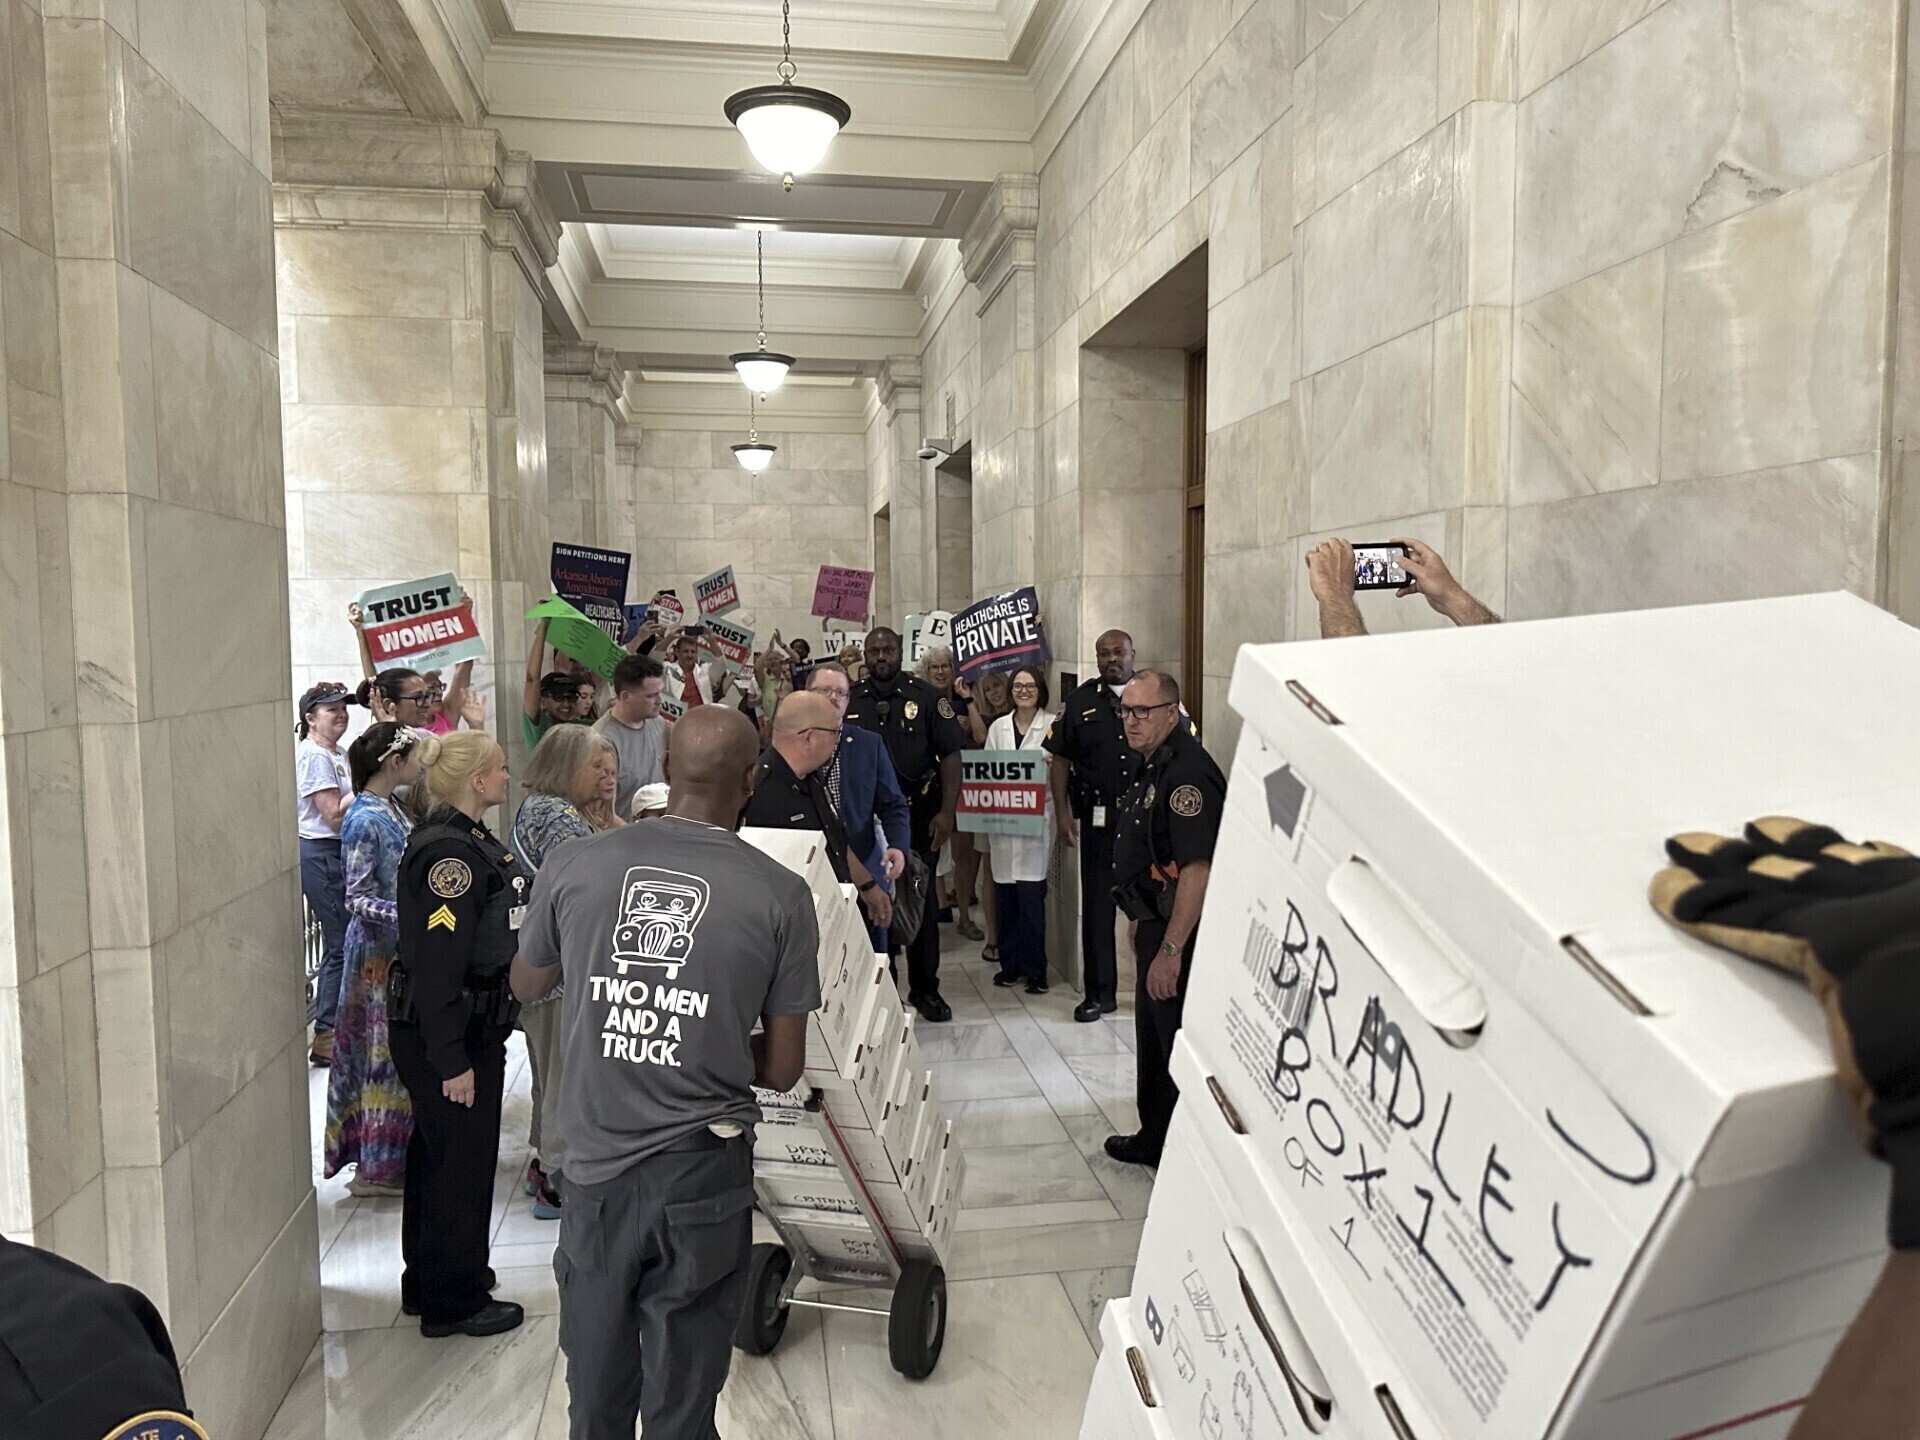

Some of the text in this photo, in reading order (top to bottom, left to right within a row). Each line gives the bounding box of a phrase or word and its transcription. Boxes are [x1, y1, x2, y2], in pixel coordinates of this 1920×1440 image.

[556, 547, 626, 564] SIGN PETITIONS HERE
[555, 568, 622, 587] Arkansas Abortion
[566, 582, 608, 596] Amendment
[697, 571, 729, 597] TRUST
[368, 586, 451, 622] TRUST
[585, 603, 615, 619] HEALTHCARE
[661, 598, 680, 610] STOP
[700, 586, 735, 612] WOMEN
[928, 618, 948, 637] E
[955, 597, 1030, 635] HEALTHCARE IS
[378, 616, 464, 653] WOMEN
[705, 620, 747, 644] TRUST
[956, 613, 1038, 661] PRIVATE
[825, 640, 839, 654] W
[962, 762, 1036, 780] TRUST
[962, 789, 1037, 809] WOMEN
[590, 976, 709, 1018] TWO MEN
[604, 1005, 682, 1042] AND A
[601, 1033, 682, 1067] TRUCK.
[1269, 898, 1592, 1312] BRADLEY
[1266, 1027, 1387, 1212] BOX
